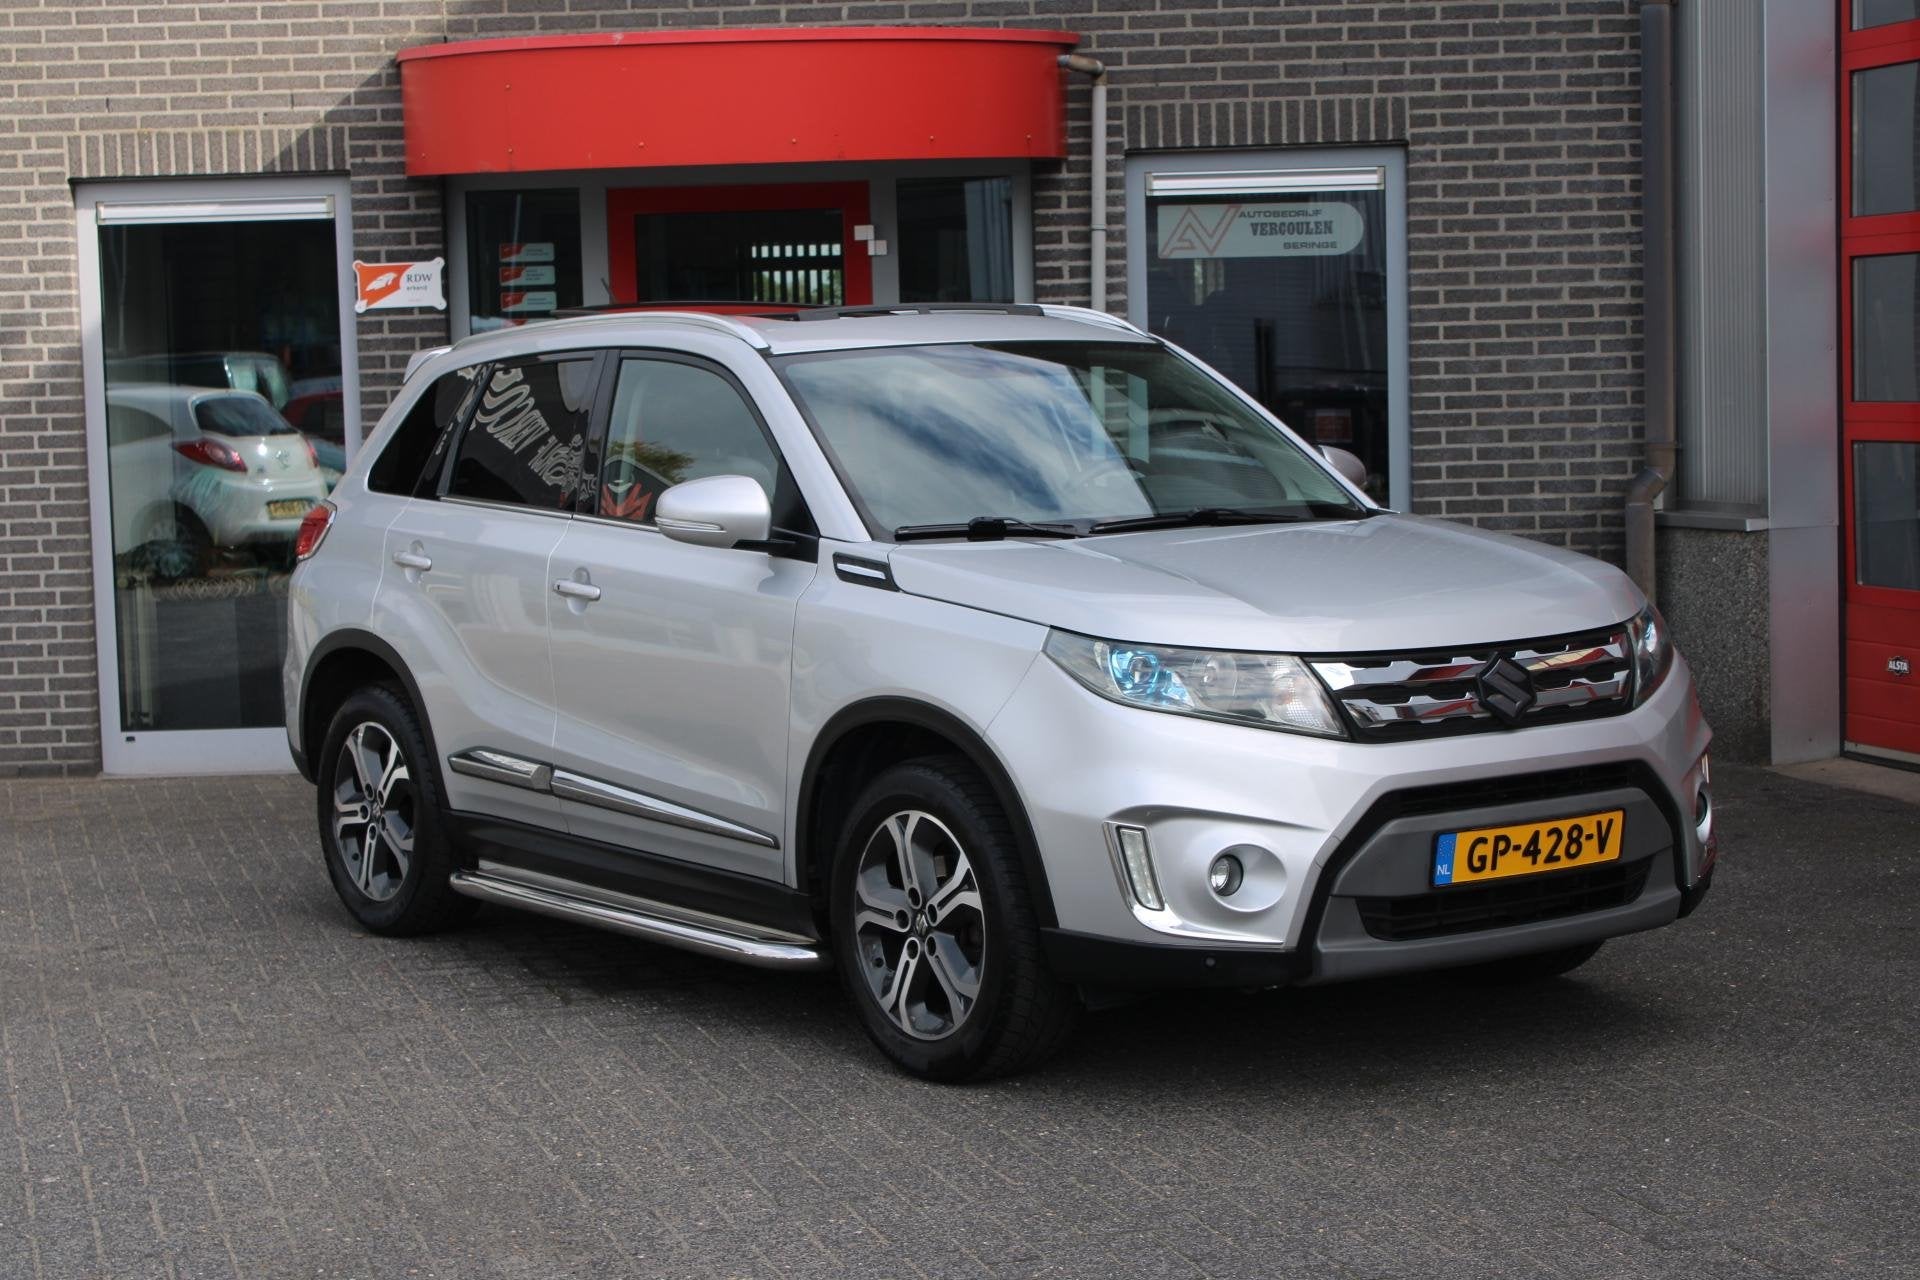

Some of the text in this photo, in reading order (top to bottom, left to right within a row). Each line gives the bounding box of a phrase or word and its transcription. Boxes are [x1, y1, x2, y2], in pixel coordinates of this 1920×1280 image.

[1238, 209, 1322, 218] AUTOBEDRIJF
[1250, 221, 1333, 236] VERCOULEN
[1283, 241, 1337, 250] BERINGE
[406, 273, 432, 282] RDW
[1888, 660, 1907, 671] ALSTA
[1437, 818, 1614, 876] NL GP-428-V
